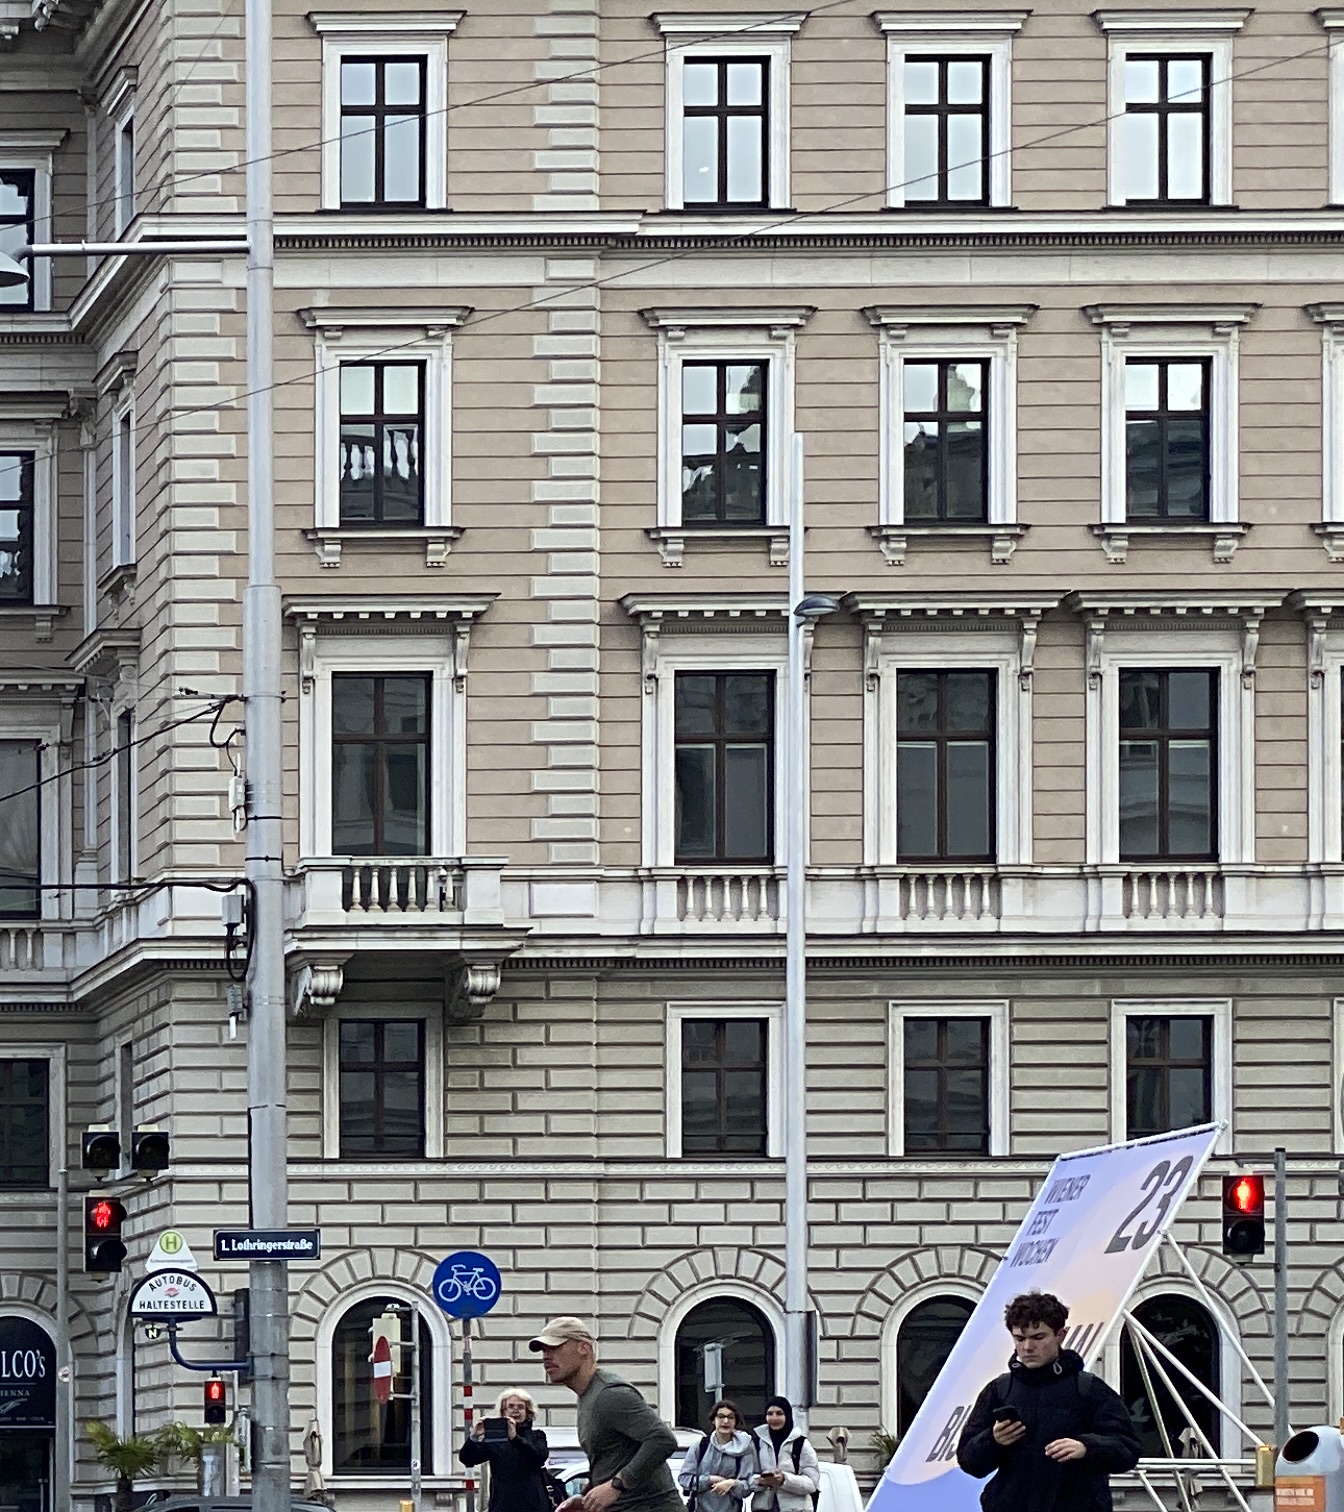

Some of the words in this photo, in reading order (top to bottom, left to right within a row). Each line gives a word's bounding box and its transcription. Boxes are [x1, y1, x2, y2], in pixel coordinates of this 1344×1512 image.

[1044, 1173, 1091, 1205] WIENER
[1103, 1155, 1194, 1255] 23
[1026, 1208, 1059, 1237] FEST
[232, 1239, 313, 1254] Lothringerstraße
[1010, 1237, 1060, 1268] WOCHEN
[148, 1275, 197, 1292] AUTOBUS
[139, 1299, 205, 1310] HALTESTELLE
[148, 1328, 157, 1338] N
